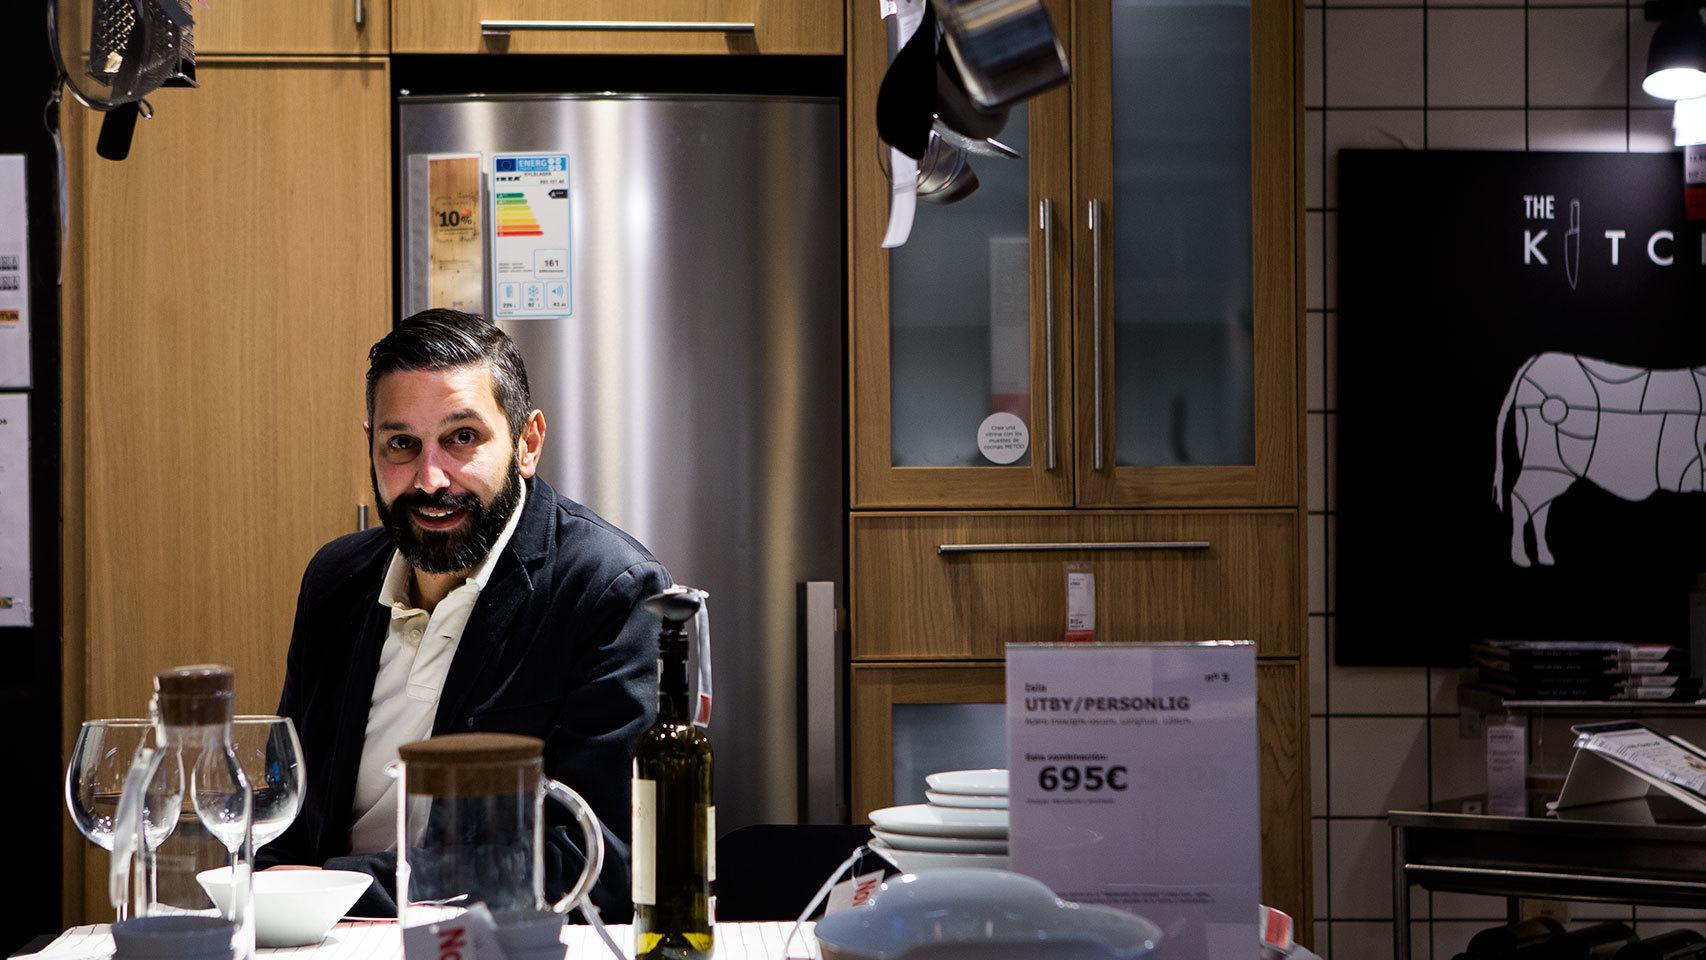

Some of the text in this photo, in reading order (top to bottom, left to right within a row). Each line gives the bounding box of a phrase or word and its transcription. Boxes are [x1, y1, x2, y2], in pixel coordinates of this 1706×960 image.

[519, 159, 547, 167] ENERG
[1523, 195, 1555, 219] THE
[439, 210, 472, 227] 10%
[1025, 697, 1191, 713] UTBY/PERSONLIG
[1038, 765, 1129, 792] 695€
